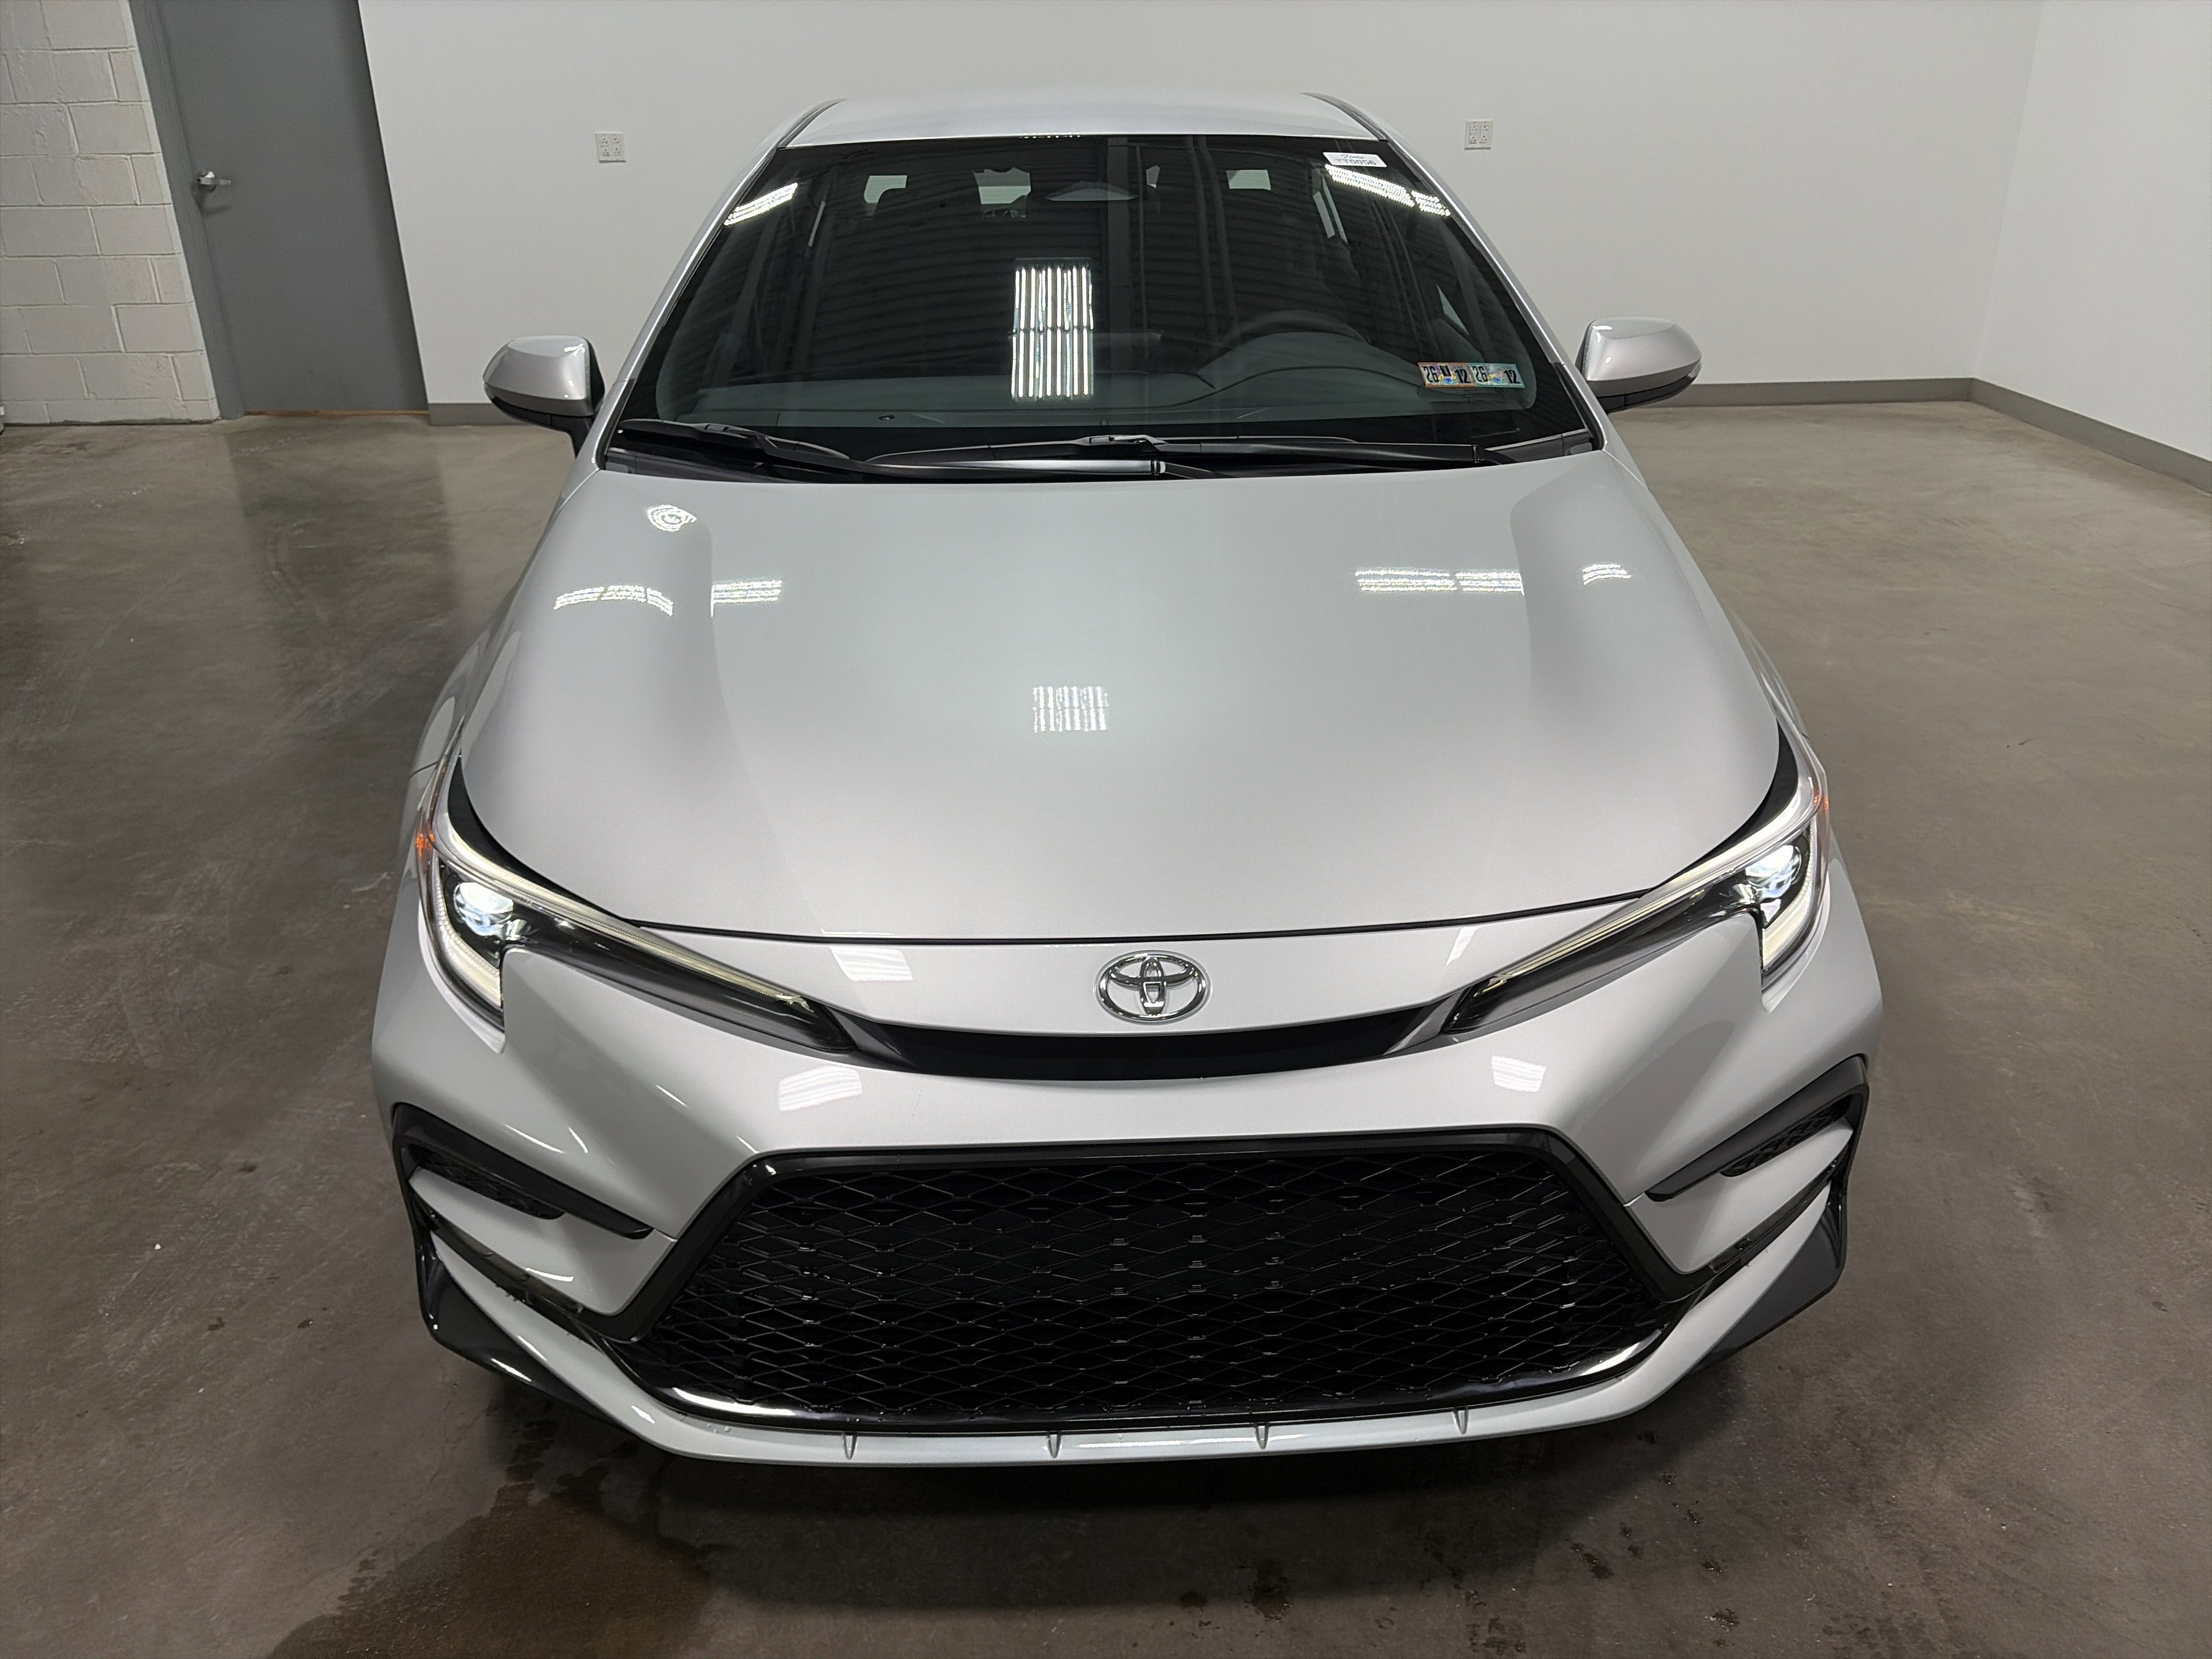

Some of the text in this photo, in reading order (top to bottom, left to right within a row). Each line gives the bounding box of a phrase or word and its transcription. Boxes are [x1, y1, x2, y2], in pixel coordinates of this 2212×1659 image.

[1423, 365, 1440, 382] 26
[1454, 369, 1471, 383] 12
[1472, 365, 1521, 384] 26 12
